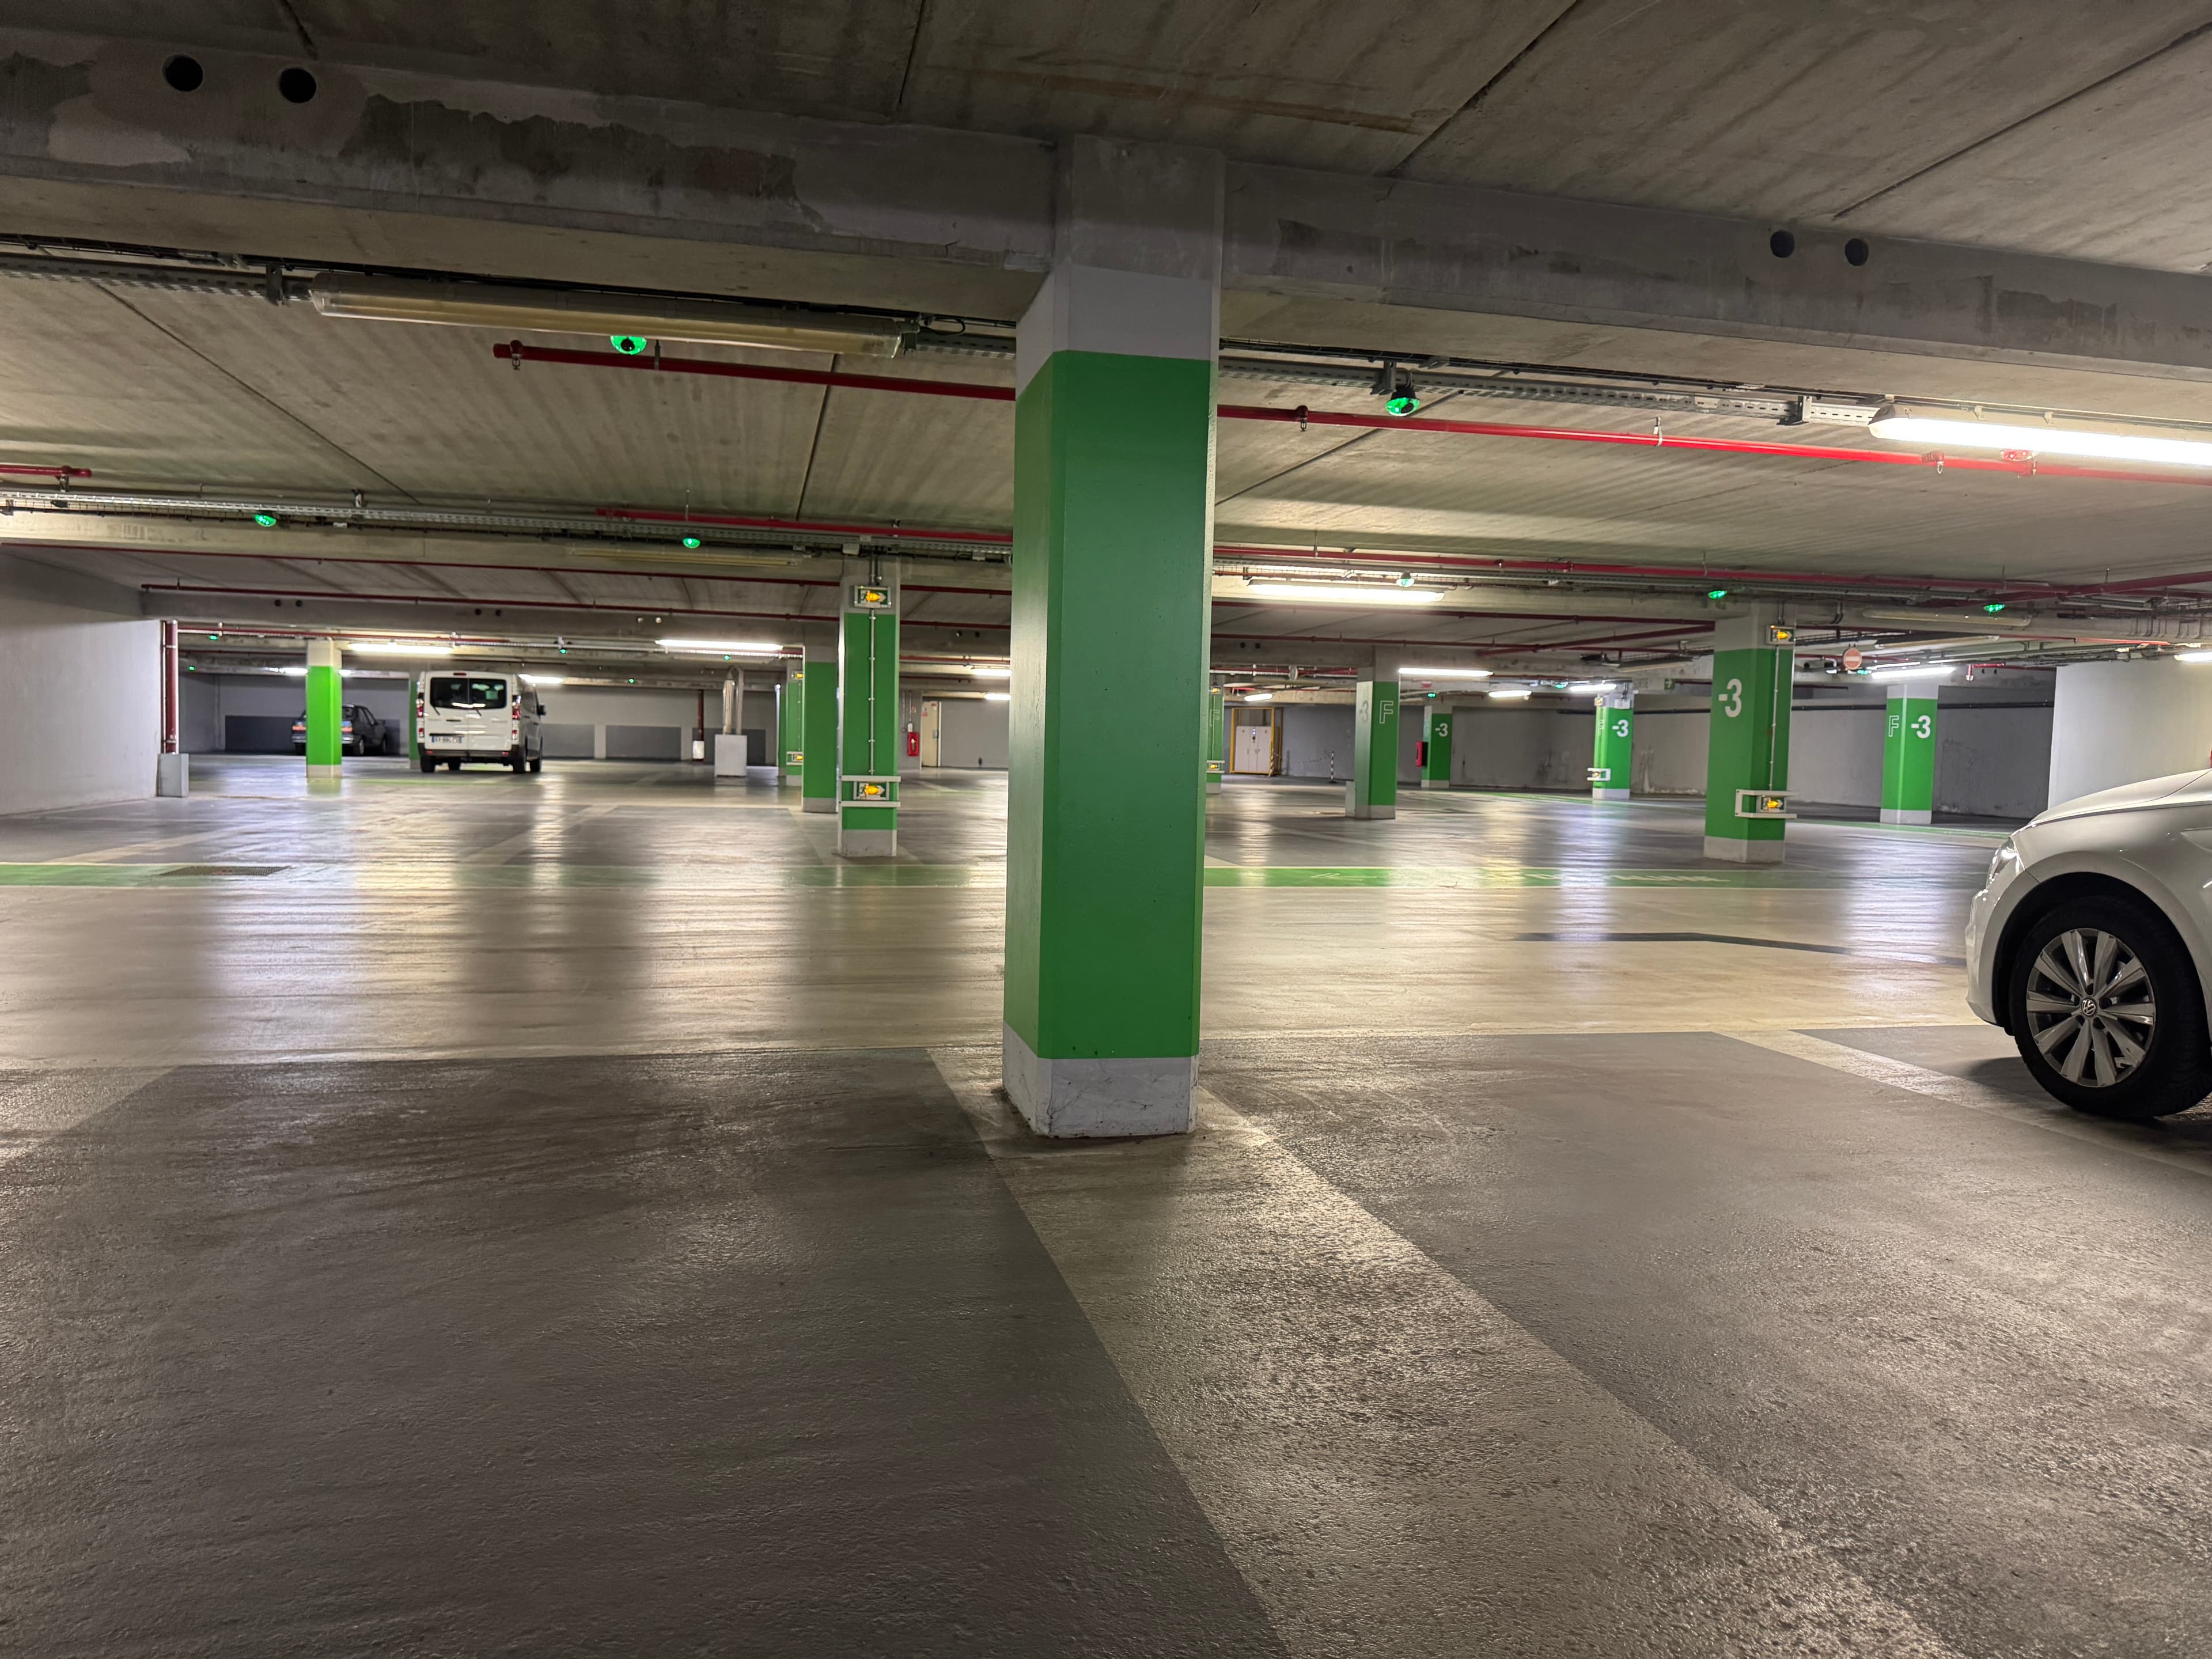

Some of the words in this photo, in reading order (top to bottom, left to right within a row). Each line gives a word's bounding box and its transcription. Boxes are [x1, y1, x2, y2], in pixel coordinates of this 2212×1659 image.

[1718, 679, 1742, 718] -3
[1379, 700, 1394, 724] F
[1435, 722, 1448, 737] -3
[1612, 719, 1629, 737] -3
[1888, 715, 1899, 737] F
[1911, 715, 1931, 738] -3
